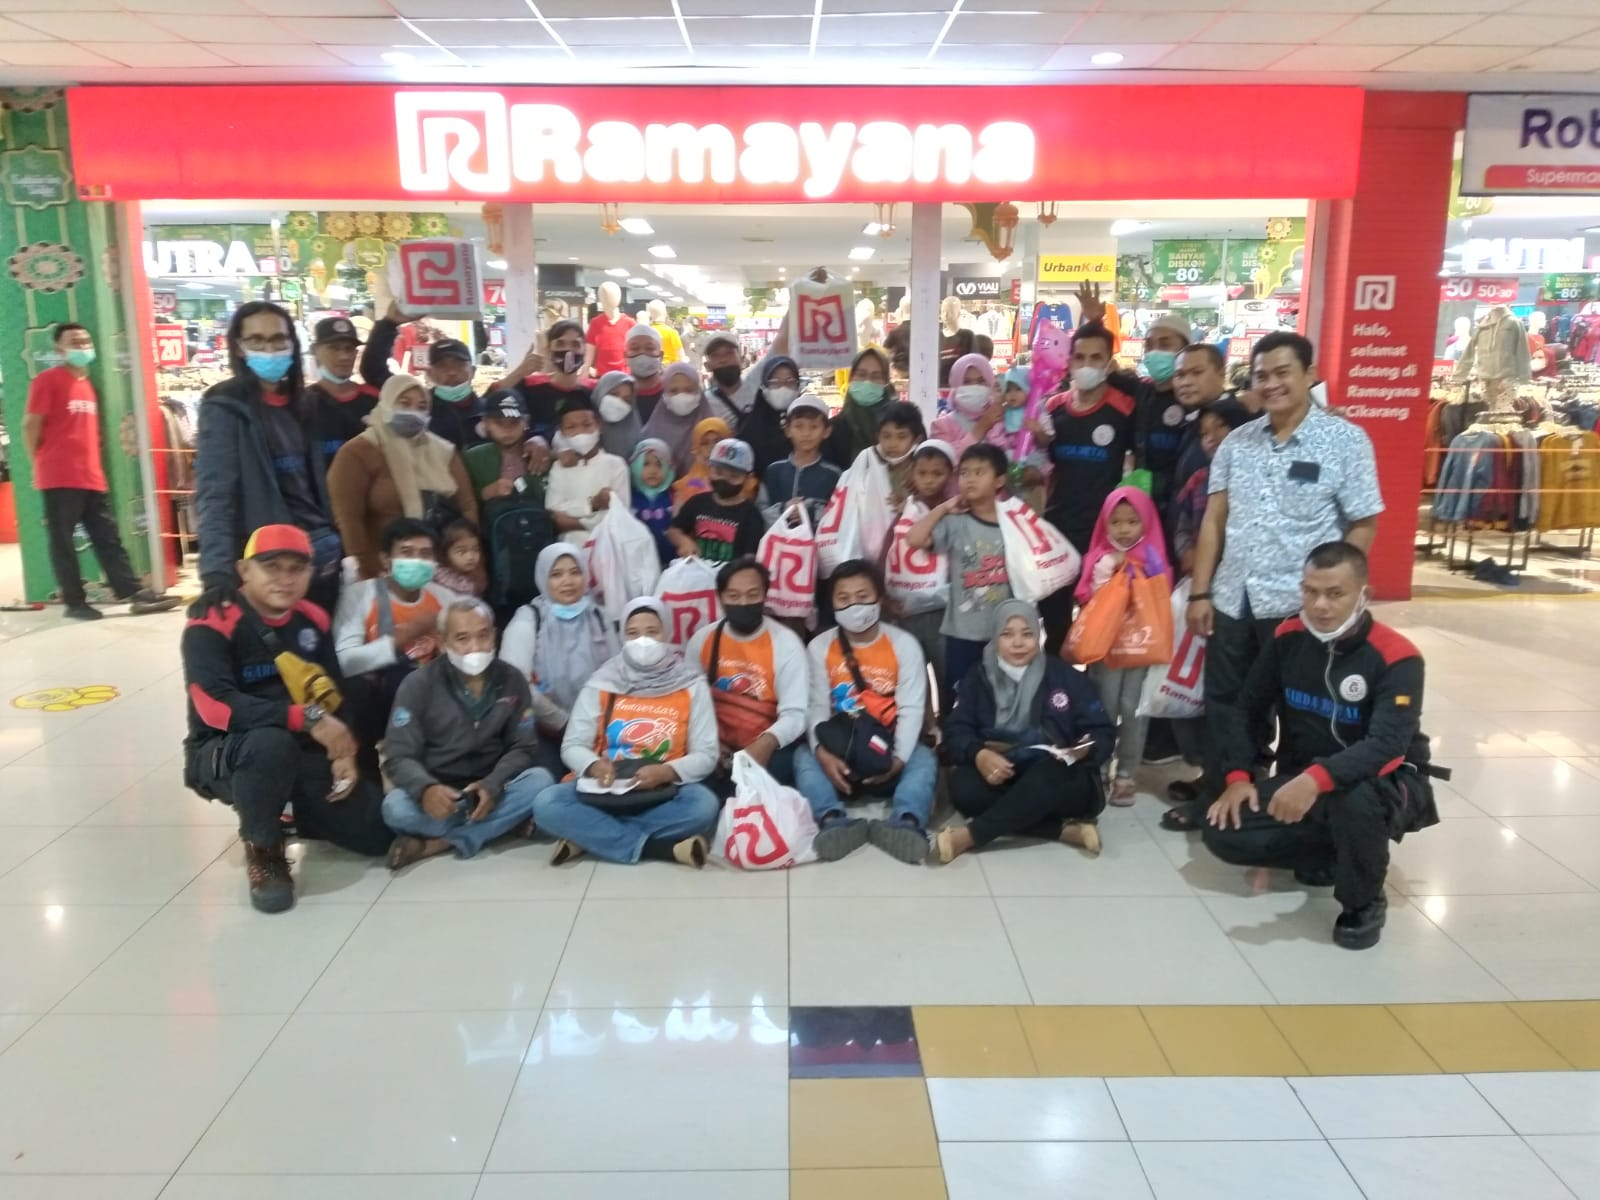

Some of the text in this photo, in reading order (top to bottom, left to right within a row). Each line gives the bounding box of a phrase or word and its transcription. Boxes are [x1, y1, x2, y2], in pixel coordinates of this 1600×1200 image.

[510, 103, 1036, 198] Ramayana
[1352, 323, 1391, 338] Halo,
[159, 338, 183, 361] 20
[1350, 343, 1408, 358] selamat
[1348, 364, 1417, 381] datang di
[1346, 385, 1421, 401] Ramayana
[1345, 404, 1410, 421] Cikarang
